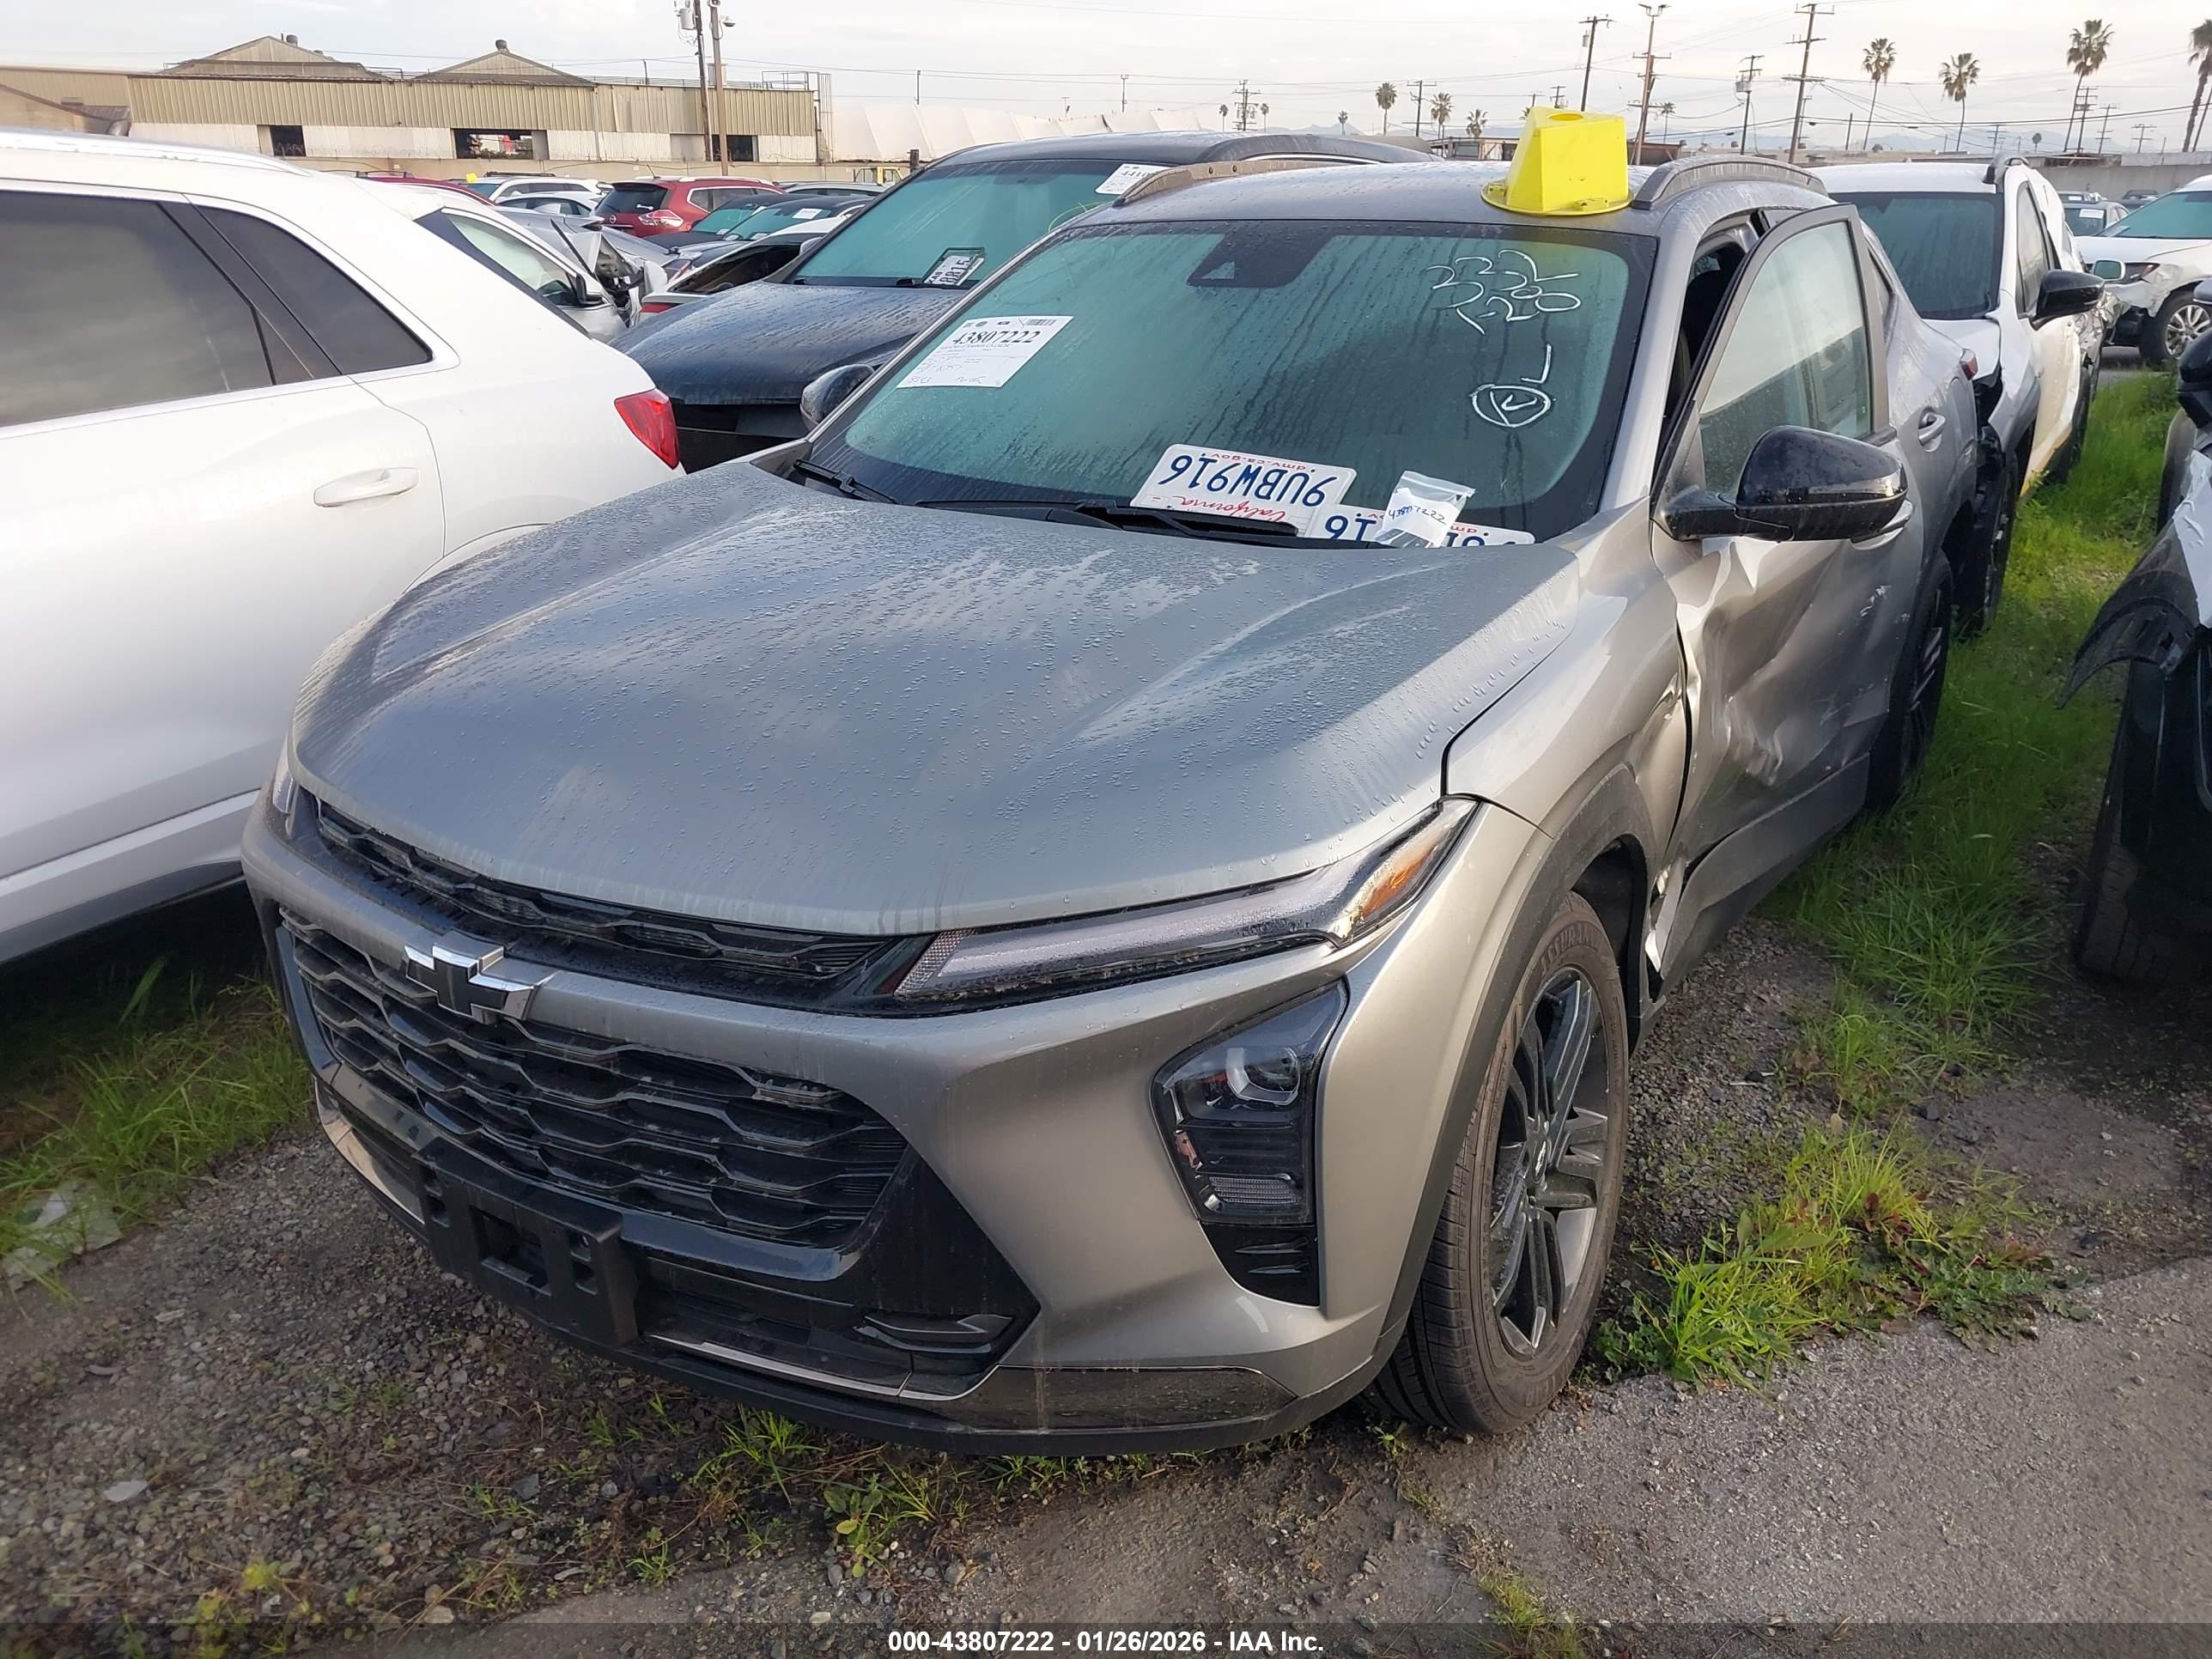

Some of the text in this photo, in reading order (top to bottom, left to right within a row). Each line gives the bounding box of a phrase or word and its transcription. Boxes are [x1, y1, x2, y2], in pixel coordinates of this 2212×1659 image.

[952, 330, 1042, 344] 43807222
[1211, 453, 1307, 471] dmv.ca.gov
[1157, 454, 1339, 507] 9UBW916
[1171, 495, 1286, 523] California
